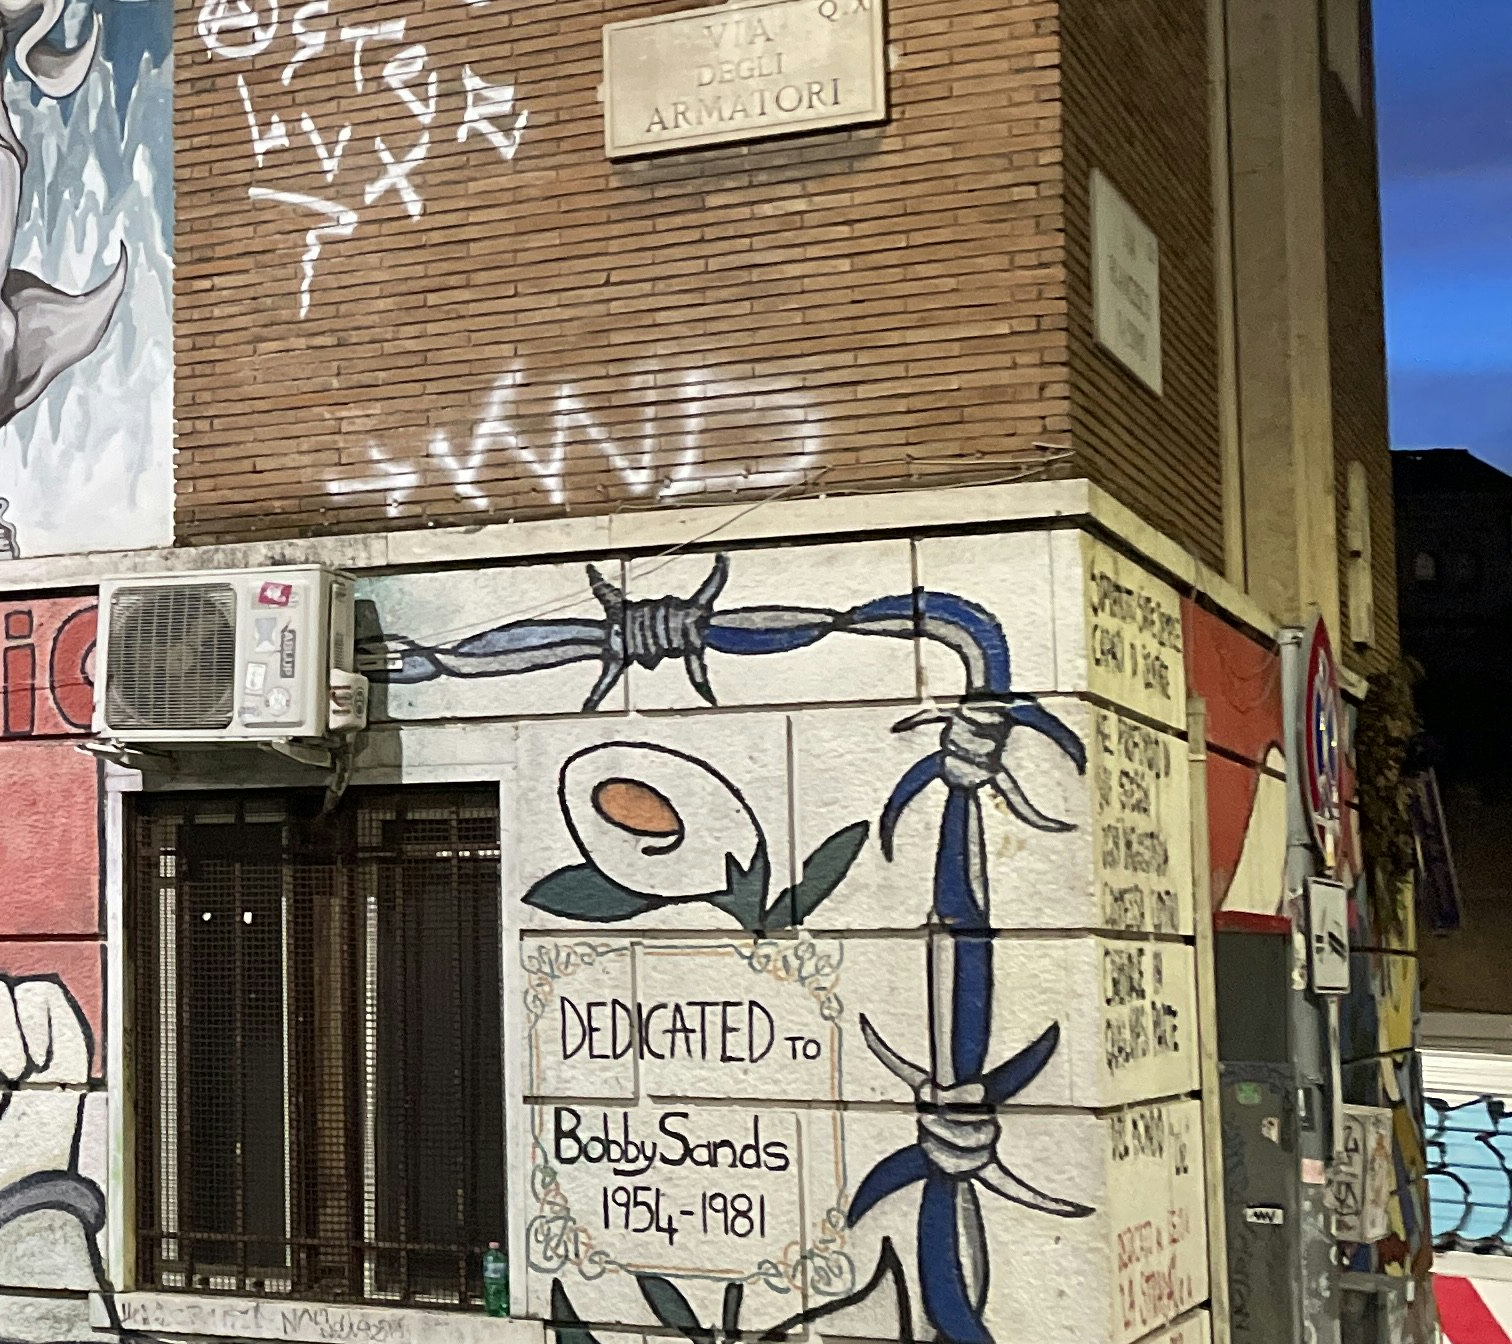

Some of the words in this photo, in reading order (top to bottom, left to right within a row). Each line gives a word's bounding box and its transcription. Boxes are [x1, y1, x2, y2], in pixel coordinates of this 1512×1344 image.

[702, 17, 775, 49] VIA
[696, 52, 785, 87] DEGLI
[644, 77, 842, 133] ARMATORI
[560, 996, 775, 1063] DEDICATED
[553, 1106, 659, 1177] Bobby
[658, 1111, 791, 1172] Sands
[601, 1185, 767, 1246] 1954-1981
